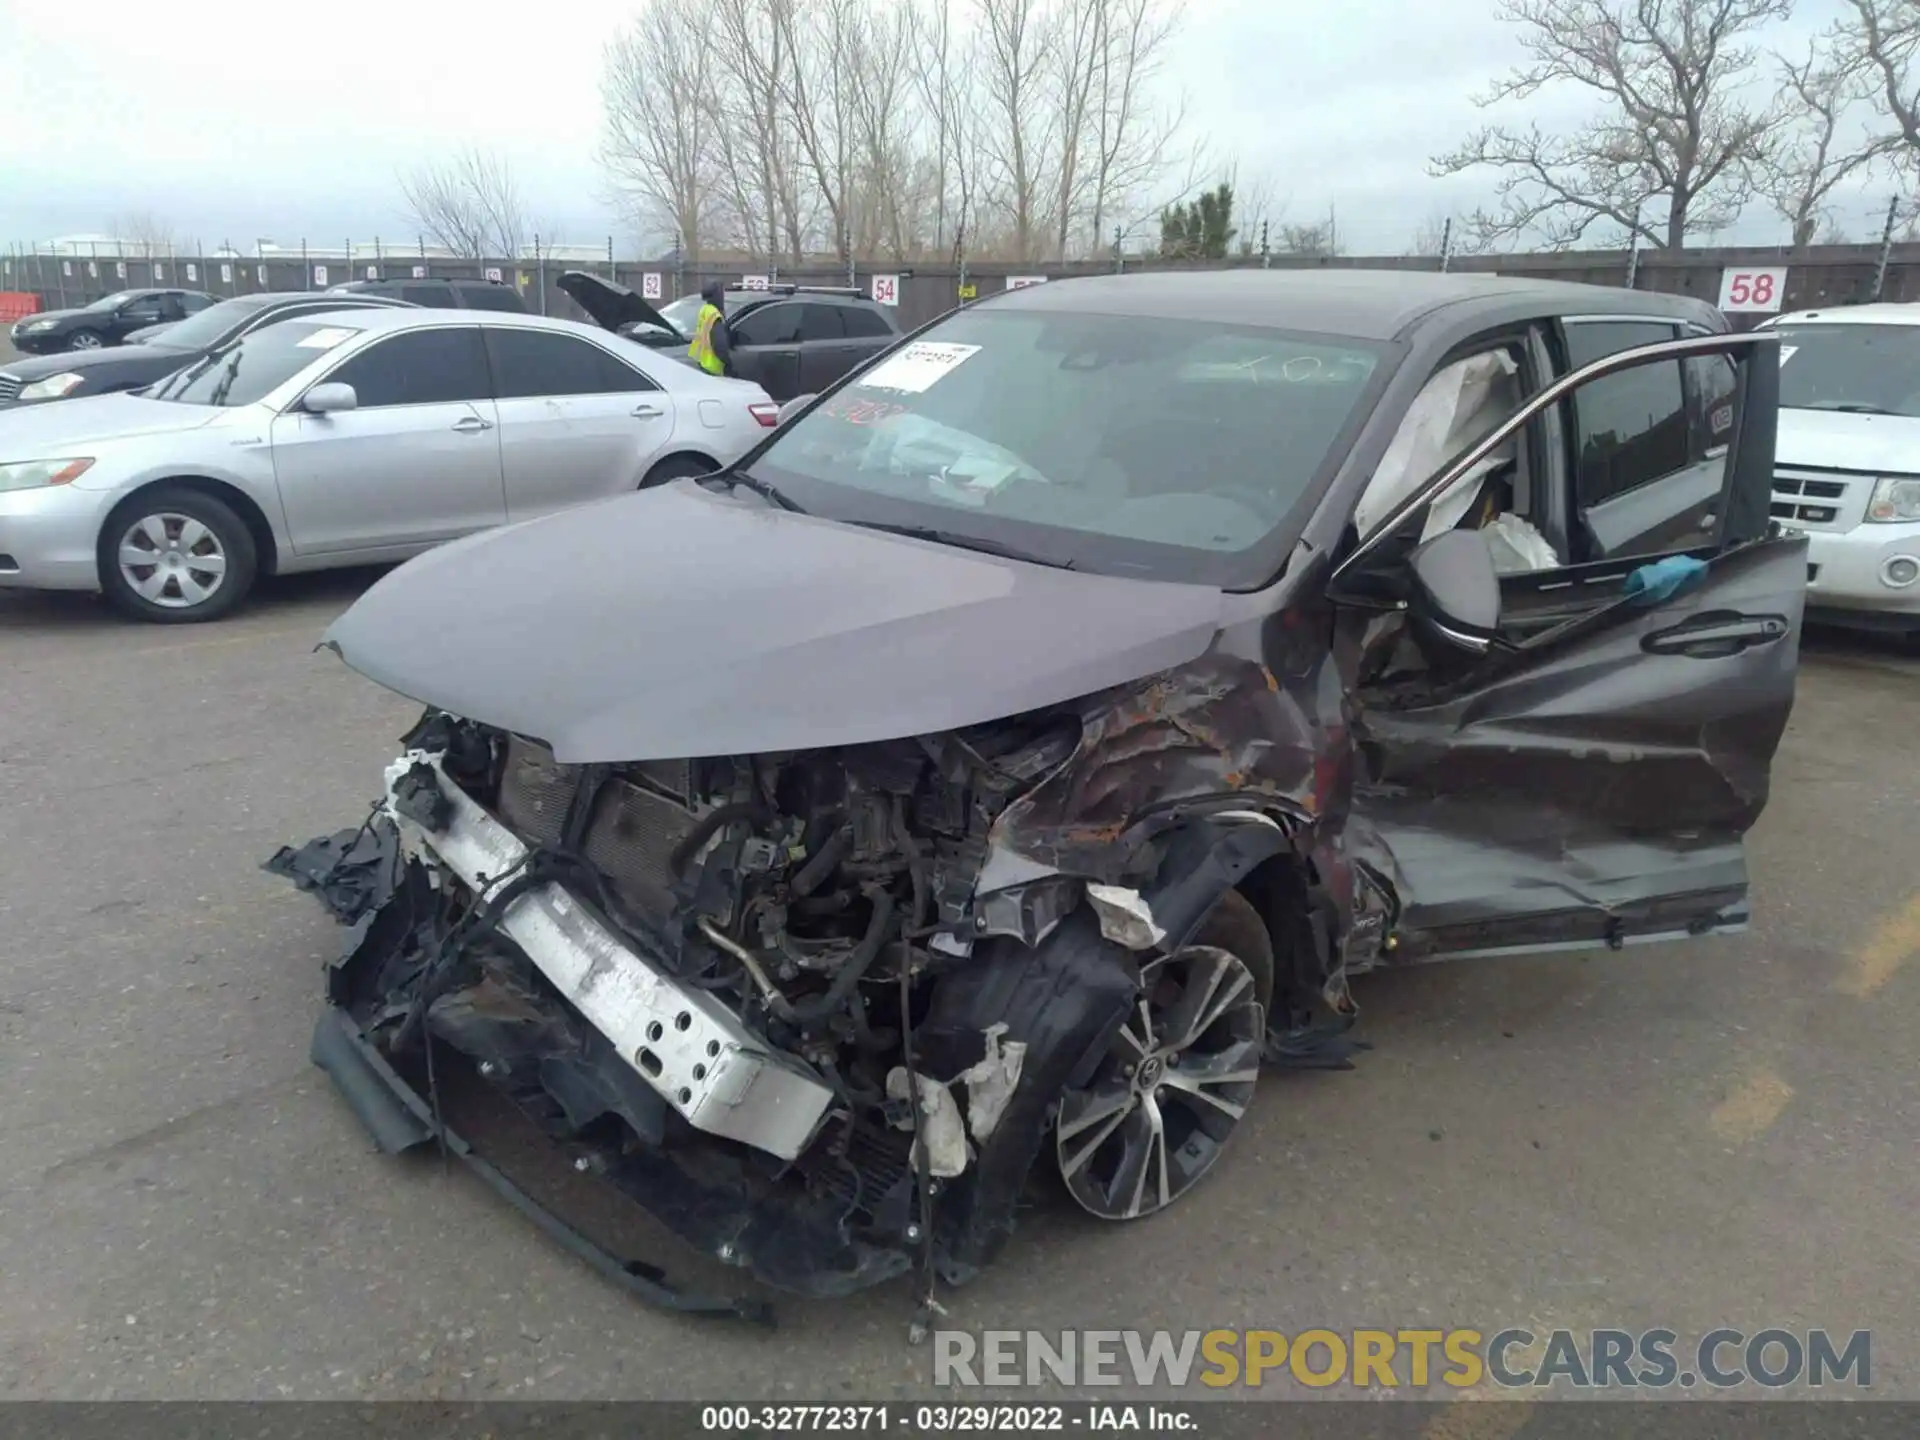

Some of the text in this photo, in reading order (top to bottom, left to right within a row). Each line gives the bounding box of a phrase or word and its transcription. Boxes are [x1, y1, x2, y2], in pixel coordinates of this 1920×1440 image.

[646, 276, 658, 294] 52
[876, 279, 895, 301] 54
[1730, 273, 1773, 304] 58
